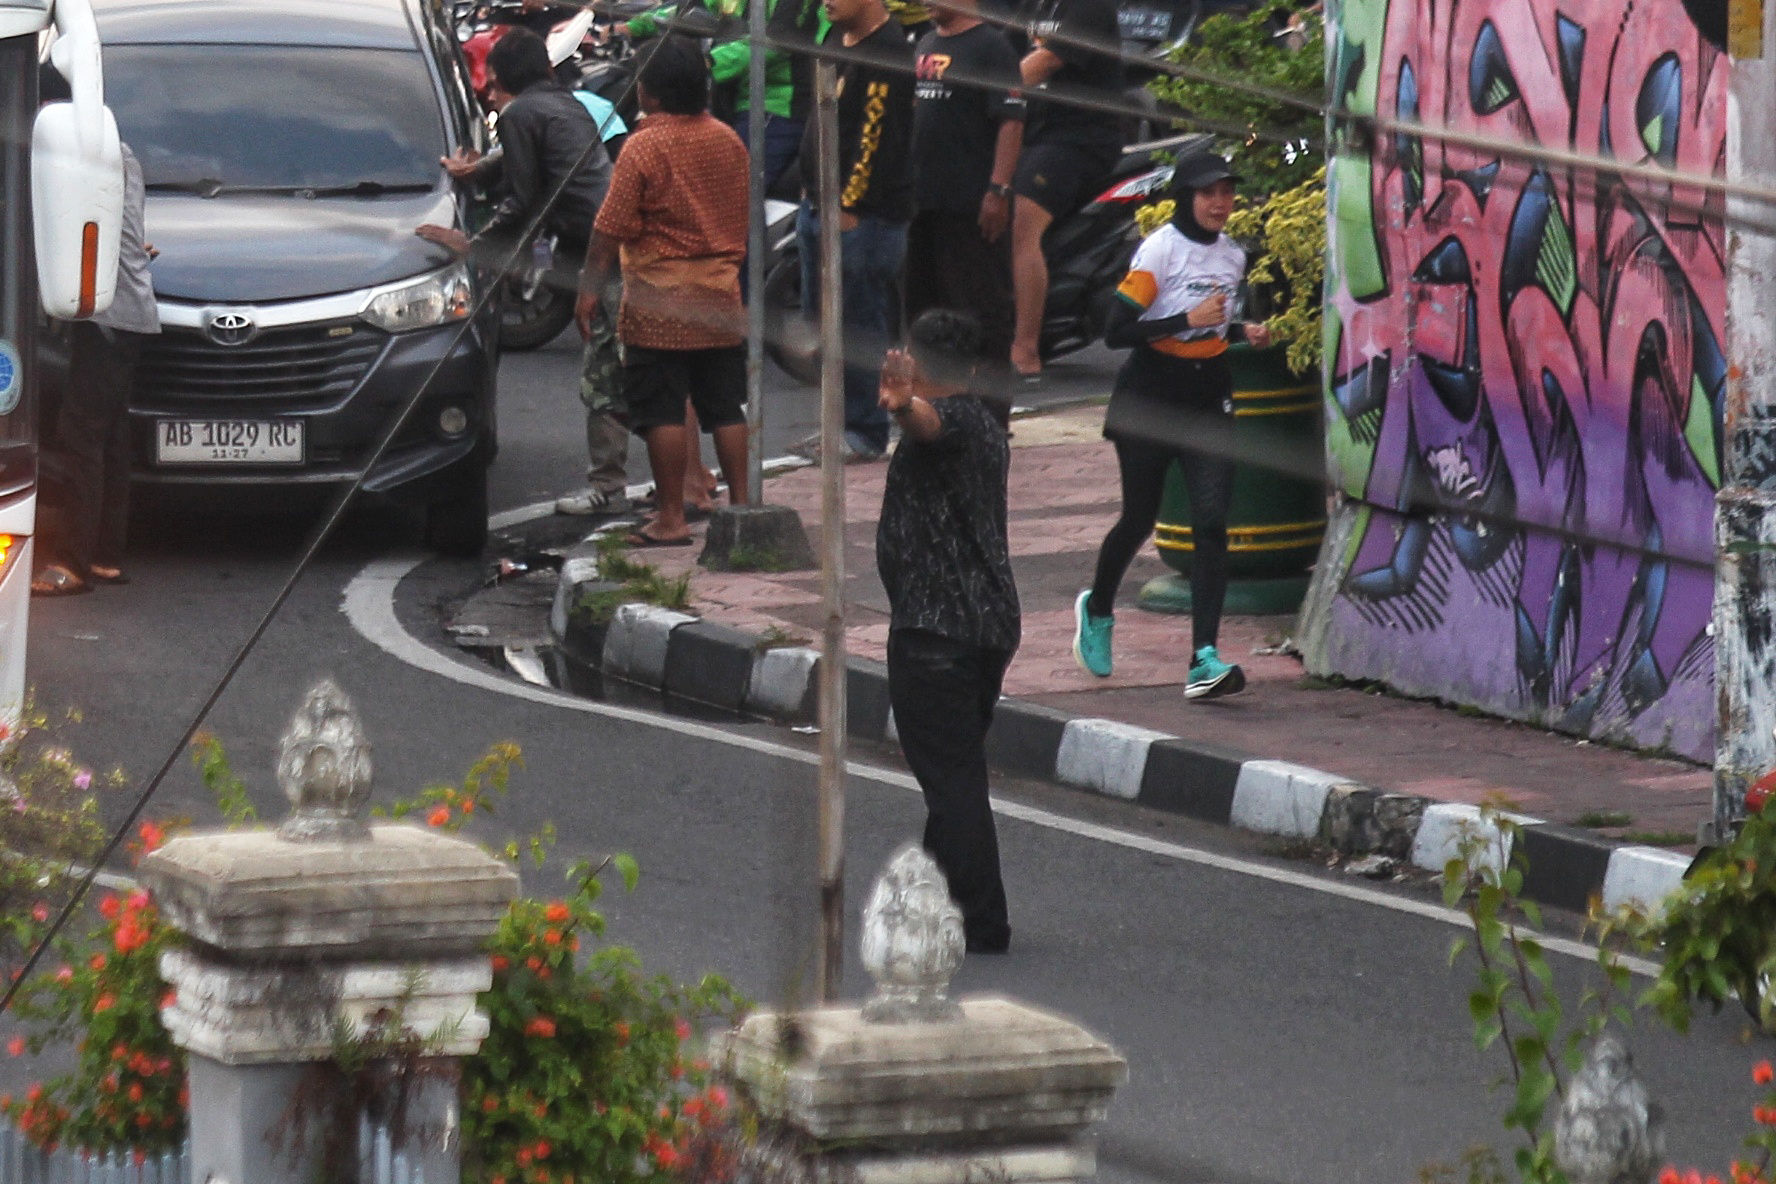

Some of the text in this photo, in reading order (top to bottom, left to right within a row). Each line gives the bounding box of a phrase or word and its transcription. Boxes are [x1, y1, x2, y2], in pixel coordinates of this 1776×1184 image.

[165, 422, 297, 448] AB 1029 RC
